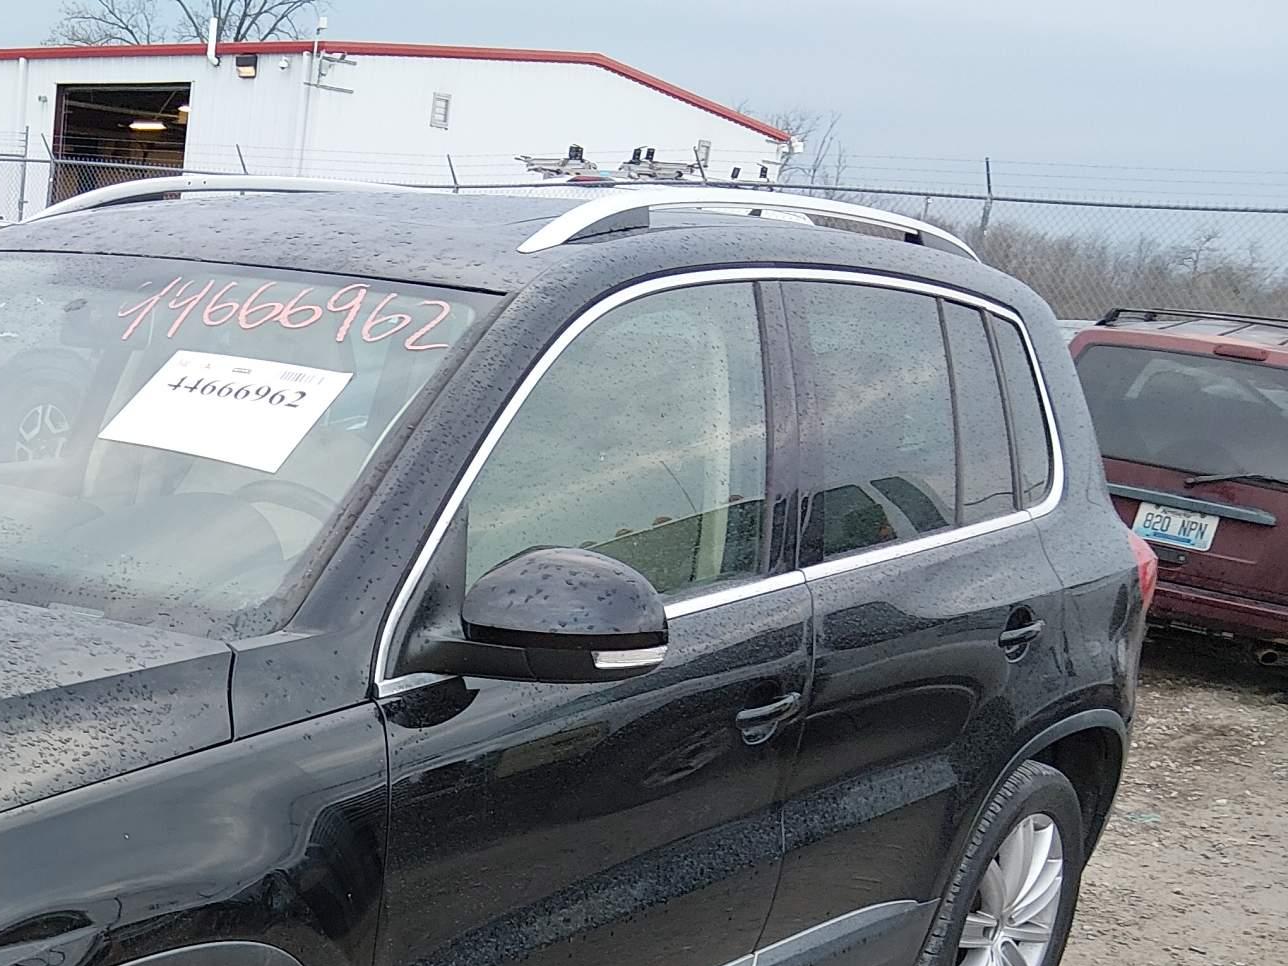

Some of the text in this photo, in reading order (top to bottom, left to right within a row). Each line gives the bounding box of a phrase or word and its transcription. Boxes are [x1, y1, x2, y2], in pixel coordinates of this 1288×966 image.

[167, 375, 307, 408] 44666962
[1143, 512, 1171, 532] 820
[1177, 519, 1209, 540] NPN
